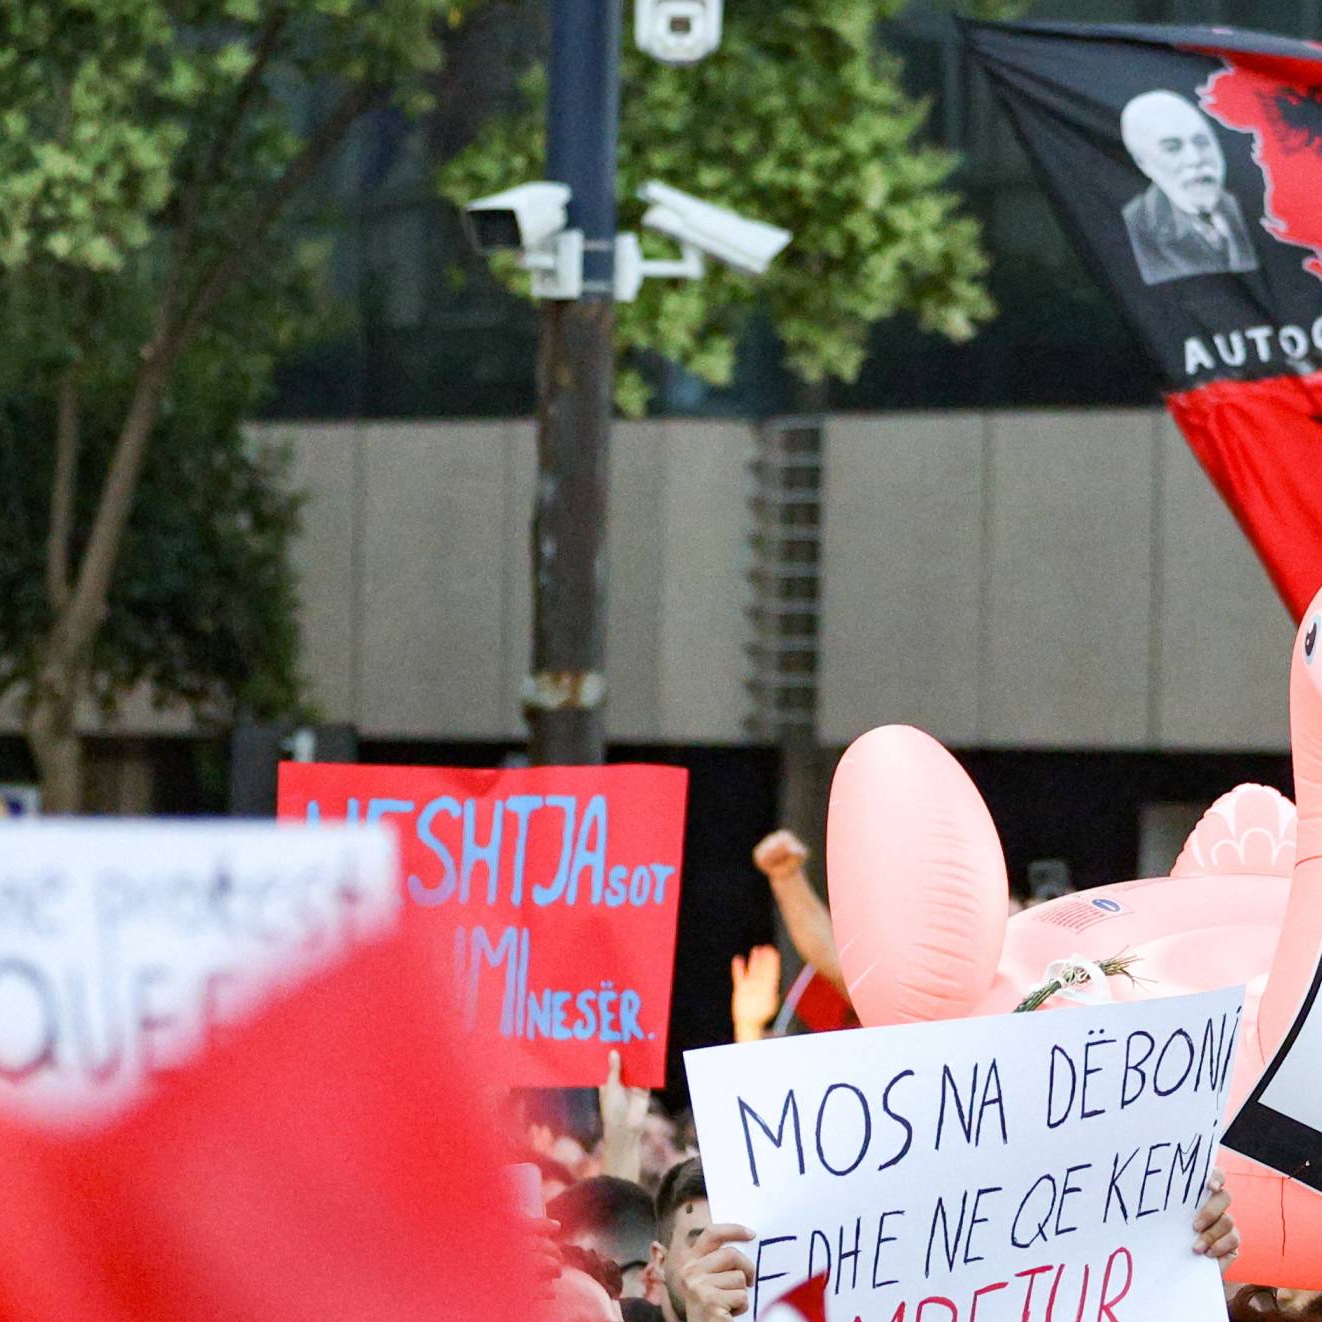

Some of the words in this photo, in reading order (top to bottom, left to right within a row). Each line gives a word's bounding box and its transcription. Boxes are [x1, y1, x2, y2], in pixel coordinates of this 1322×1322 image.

[737, 1069, 916, 1188] MOS
[934, 1058, 1009, 1151] NA
[924, 1185, 1003, 1280] NE
[1010, 1163, 1093, 1250] QE
